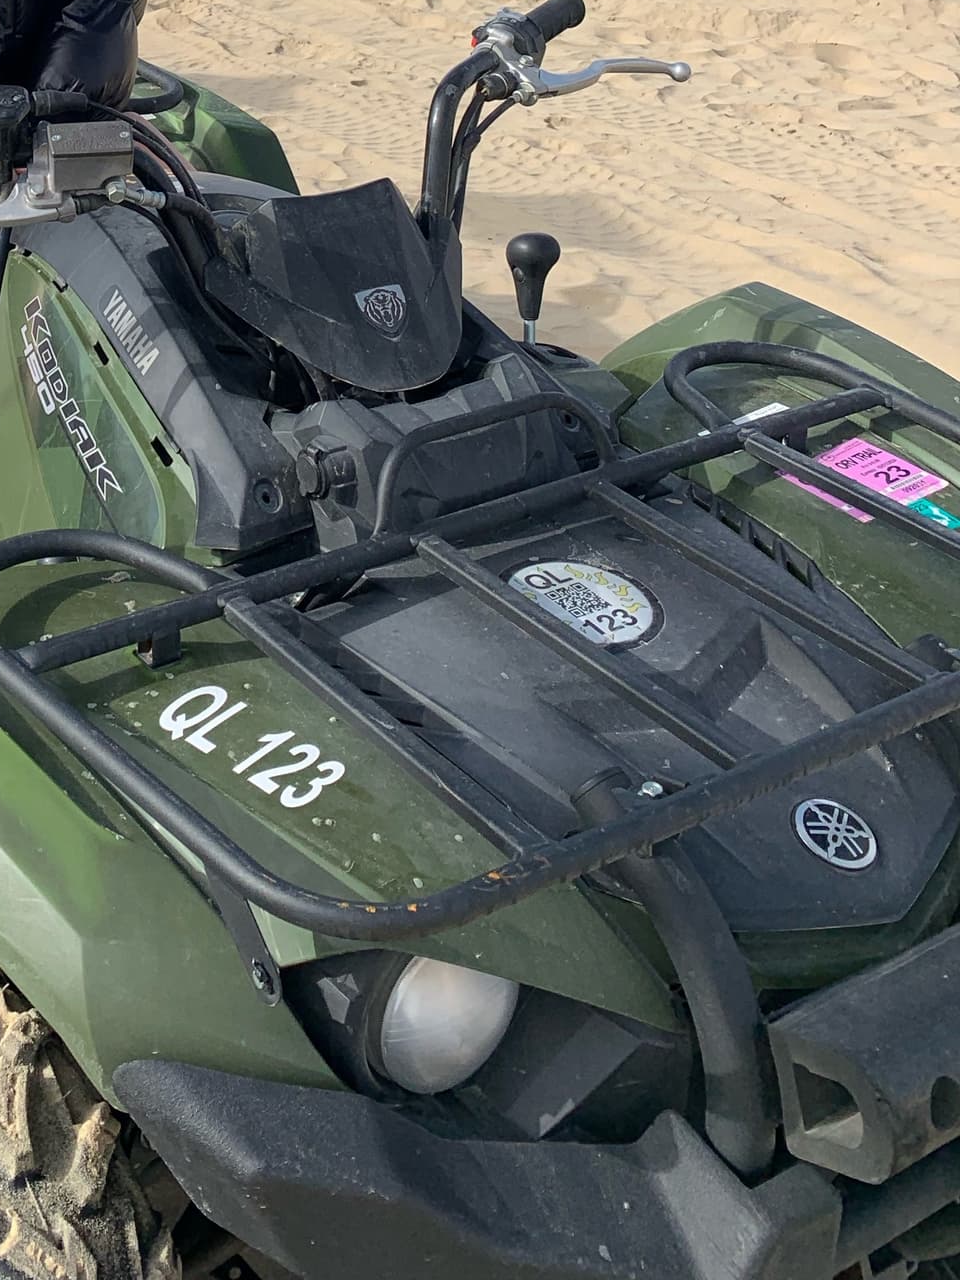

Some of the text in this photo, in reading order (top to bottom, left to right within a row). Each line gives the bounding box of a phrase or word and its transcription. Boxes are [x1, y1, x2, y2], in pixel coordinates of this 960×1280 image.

[20, 324, 56, 416] 450
[102, 289, 161, 376] YAMAHA
[24, 296, 124, 502] KODIAK
[874, 465, 911, 485] 23
[523, 569, 574, 590] QL
[582, 608, 638, 636] 123
[158, 685, 346, 808] QL 123
